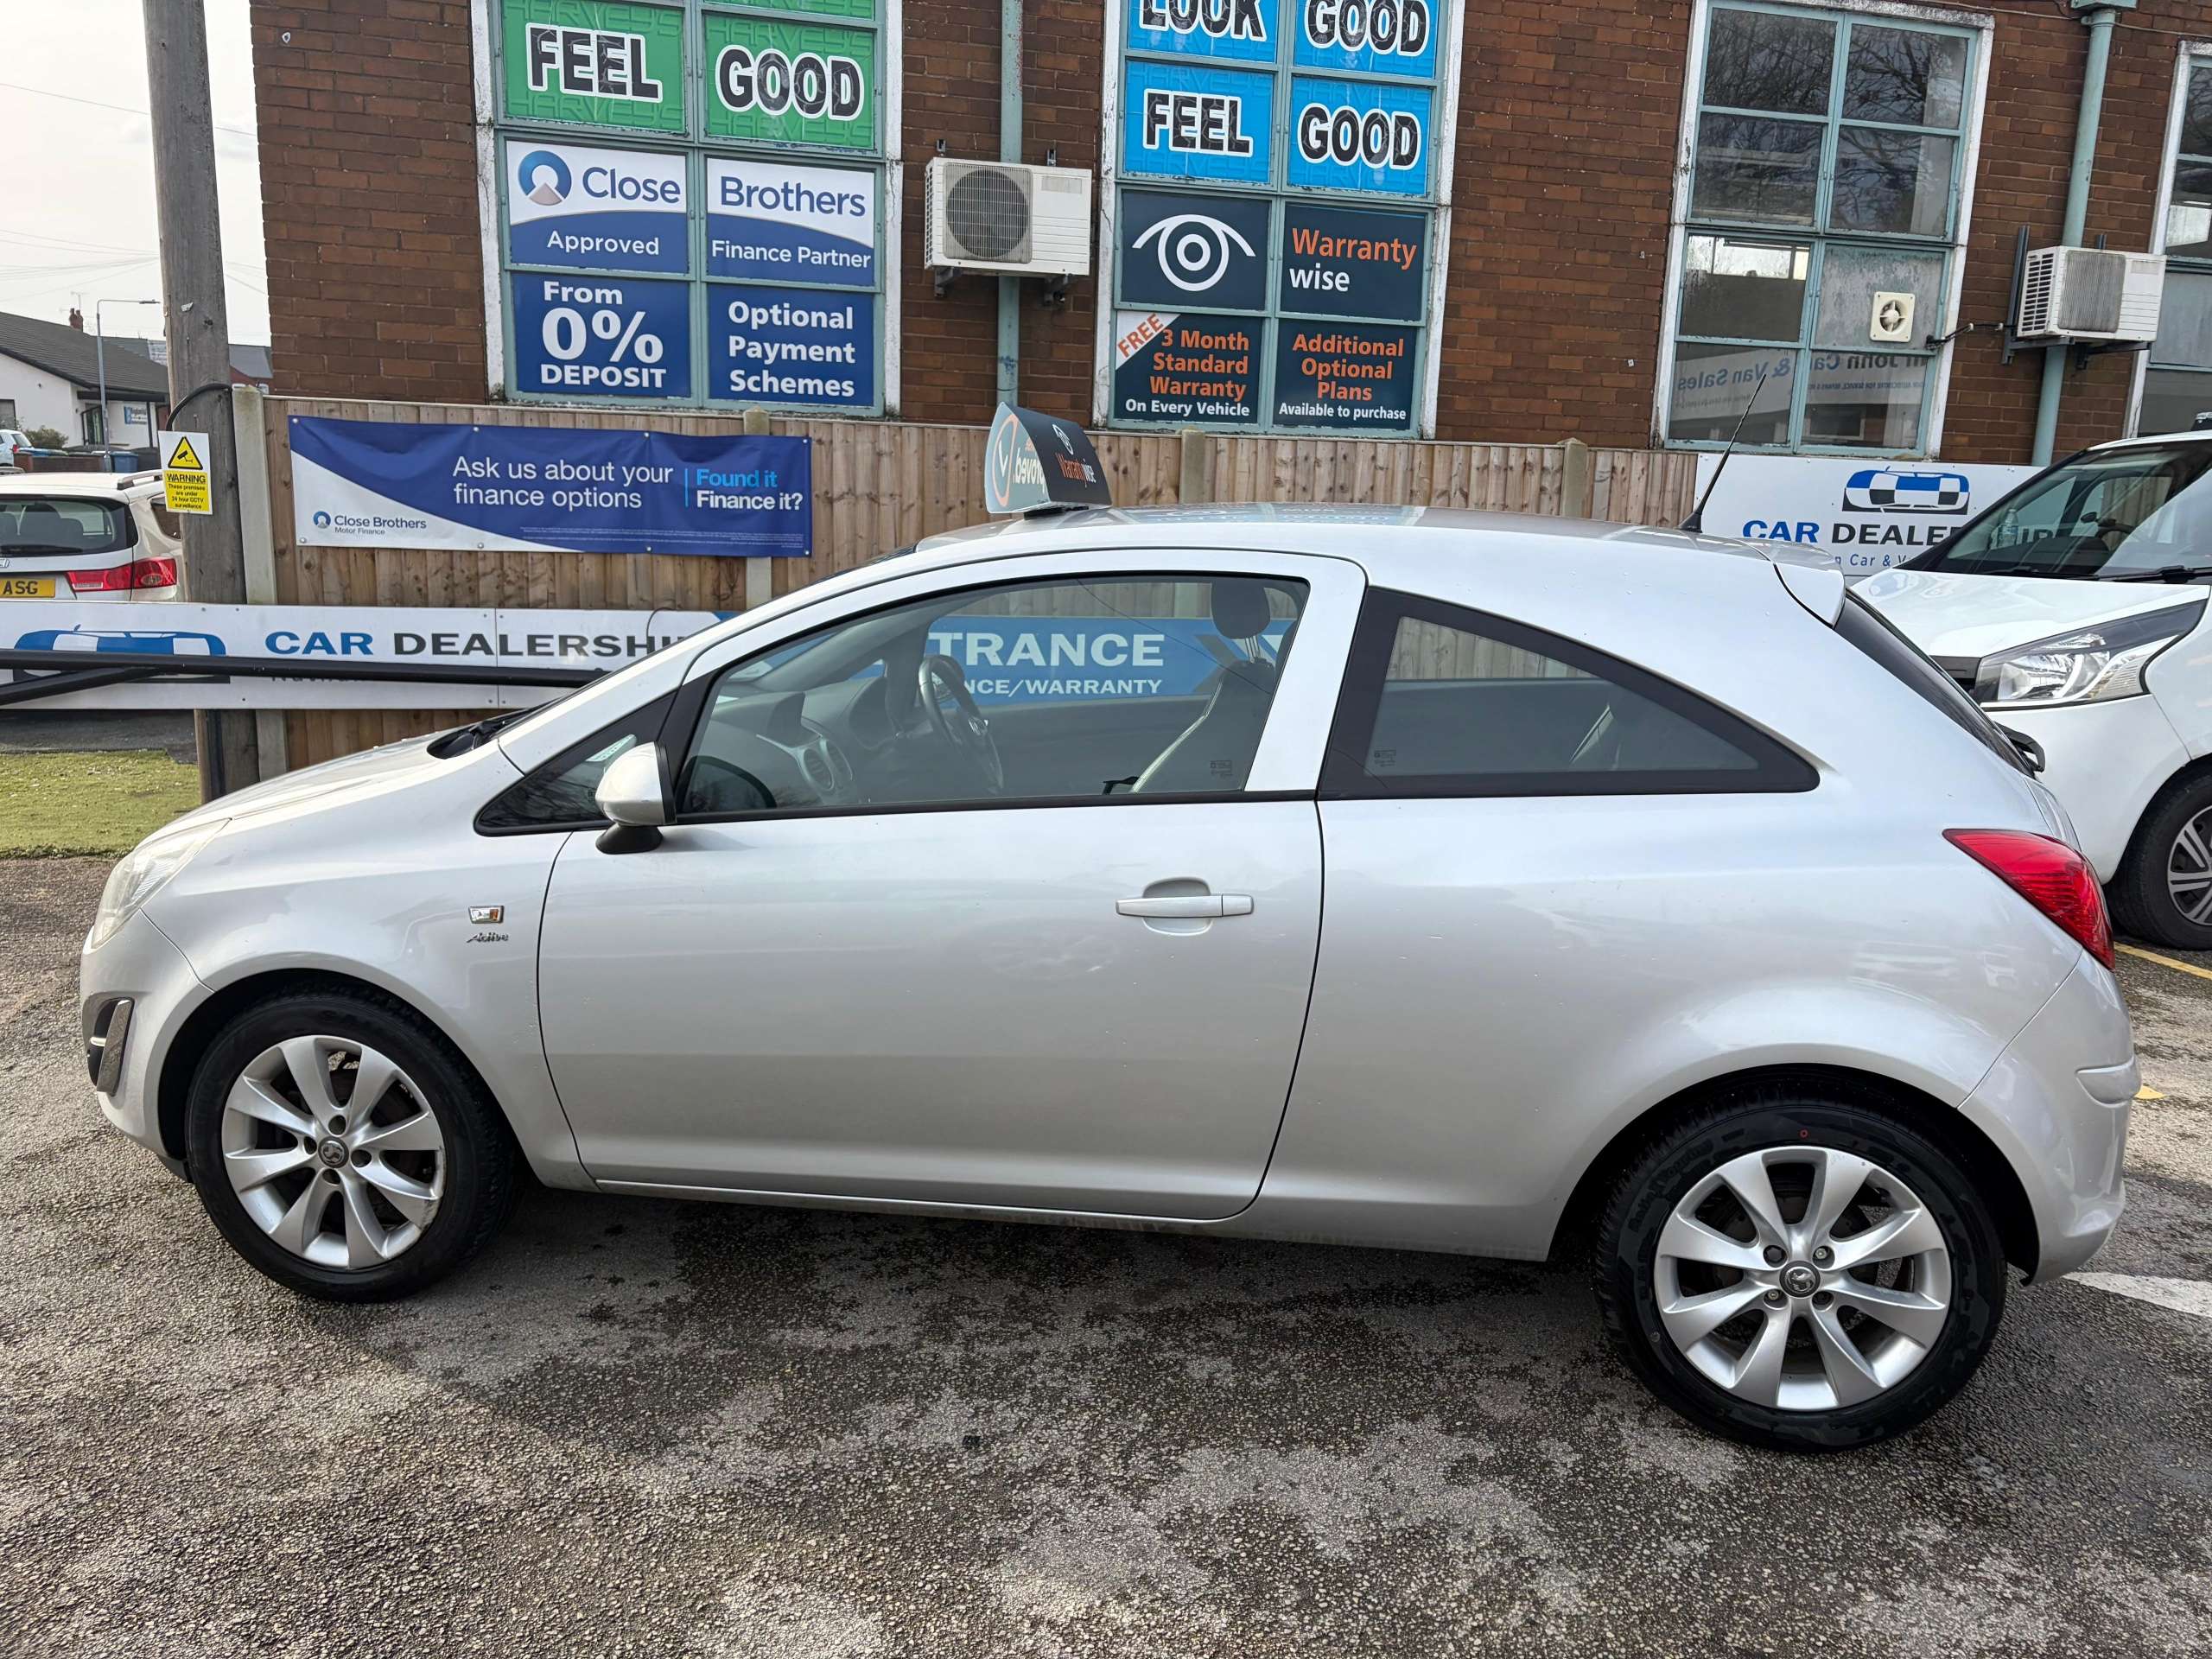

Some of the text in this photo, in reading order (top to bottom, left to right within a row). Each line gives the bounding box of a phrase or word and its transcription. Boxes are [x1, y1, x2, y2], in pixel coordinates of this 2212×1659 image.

[1307, 0, 1427, 53] GOOD
[528, 25, 660, 101] FEEL
[717, 48, 862, 118] GOOD
[1145, 91, 1251, 155] FEEL
[1300, 105, 1420, 168] GOOD
[582, 167, 866, 217] Close Brothers
[547, 231, 659, 256] Approved
[712, 239, 872, 269] Finance Partner
[1293, 227, 1417, 270] Warranty
[1288, 263, 1351, 292] wise
[543, 281, 623, 305] From
[728, 301, 854, 330] Optional
[541, 308, 664, 364] 0%
[1117, 313, 1164, 359] FREE
[1161, 329, 1249, 351] 3 Month
[1292, 334, 1404, 357] Additional
[728, 335, 855, 365] Payment
[1153, 352, 1249, 374] Standard
[540, 364, 667, 389] DEPOSIT
[1301, 357, 1393, 381] Optional
[729, 369, 855, 397] Schemes
[1149, 376, 1247, 402] Warranty
[1317, 381, 1373, 401] Plans
[1125, 398, 1250, 416] On Every Vehicle
[1279, 402, 1407, 421] Available to purchase
[167, 474, 207, 484] WARNING
[453, 456, 674, 486] Ask us about your
[696, 468, 778, 487] Found it
[454, 483, 642, 512] finance options
[696, 490, 804, 511] Finance it?
[334, 515, 427, 529] Close Brothers
[1742, 519, 1960, 545] CAR DEALE
[1850, 553, 1876, 567] Car
[1882, 554, 1891, 567] &
[3, 580, 39, 595] ASG
[264, 631, 683, 658] CAR DEALERSHI
[928, 632, 1165, 667] TRANCE
